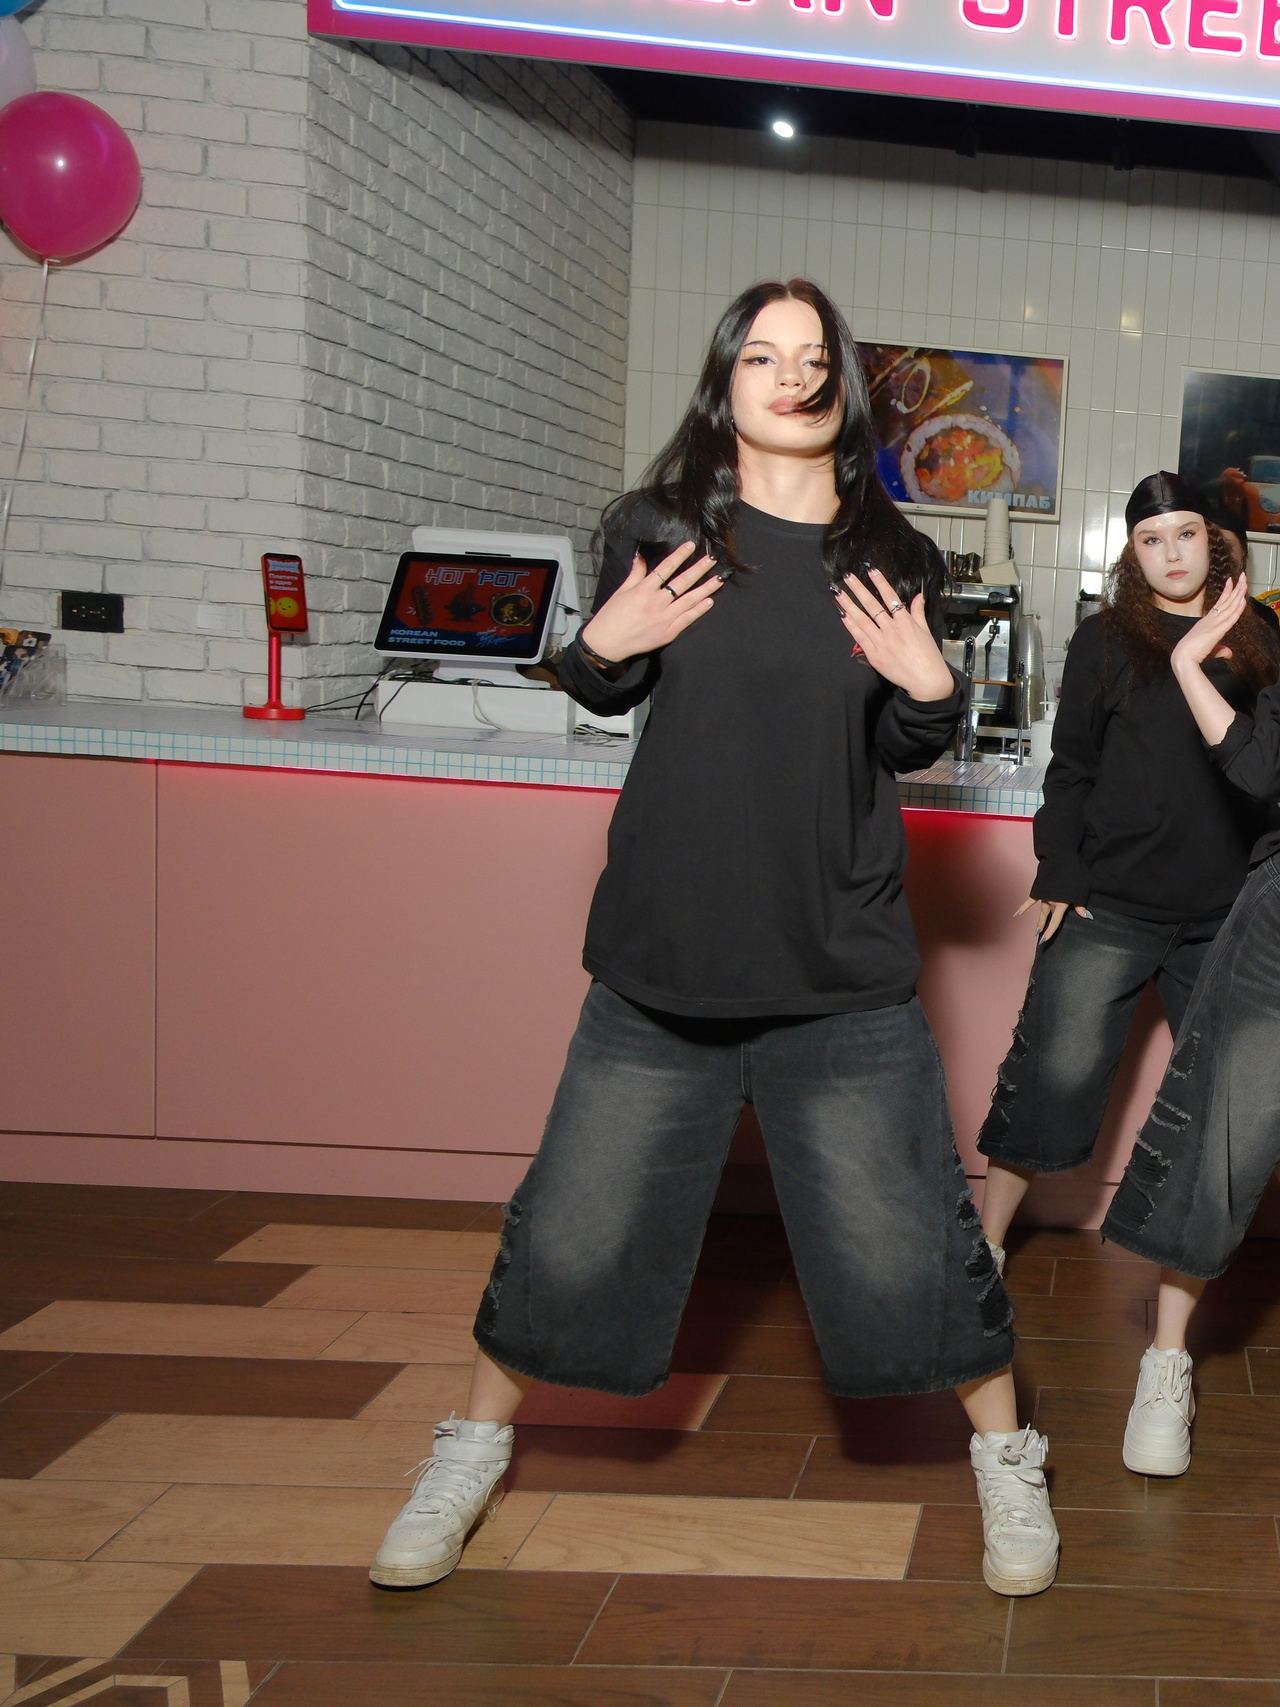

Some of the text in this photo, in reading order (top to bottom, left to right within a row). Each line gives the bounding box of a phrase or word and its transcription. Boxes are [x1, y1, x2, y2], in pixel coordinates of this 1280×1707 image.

[425, 566, 530, 587] HOT POT
[390, 629, 438, 637] KOREAN
[388, 636, 432, 645] STREET
